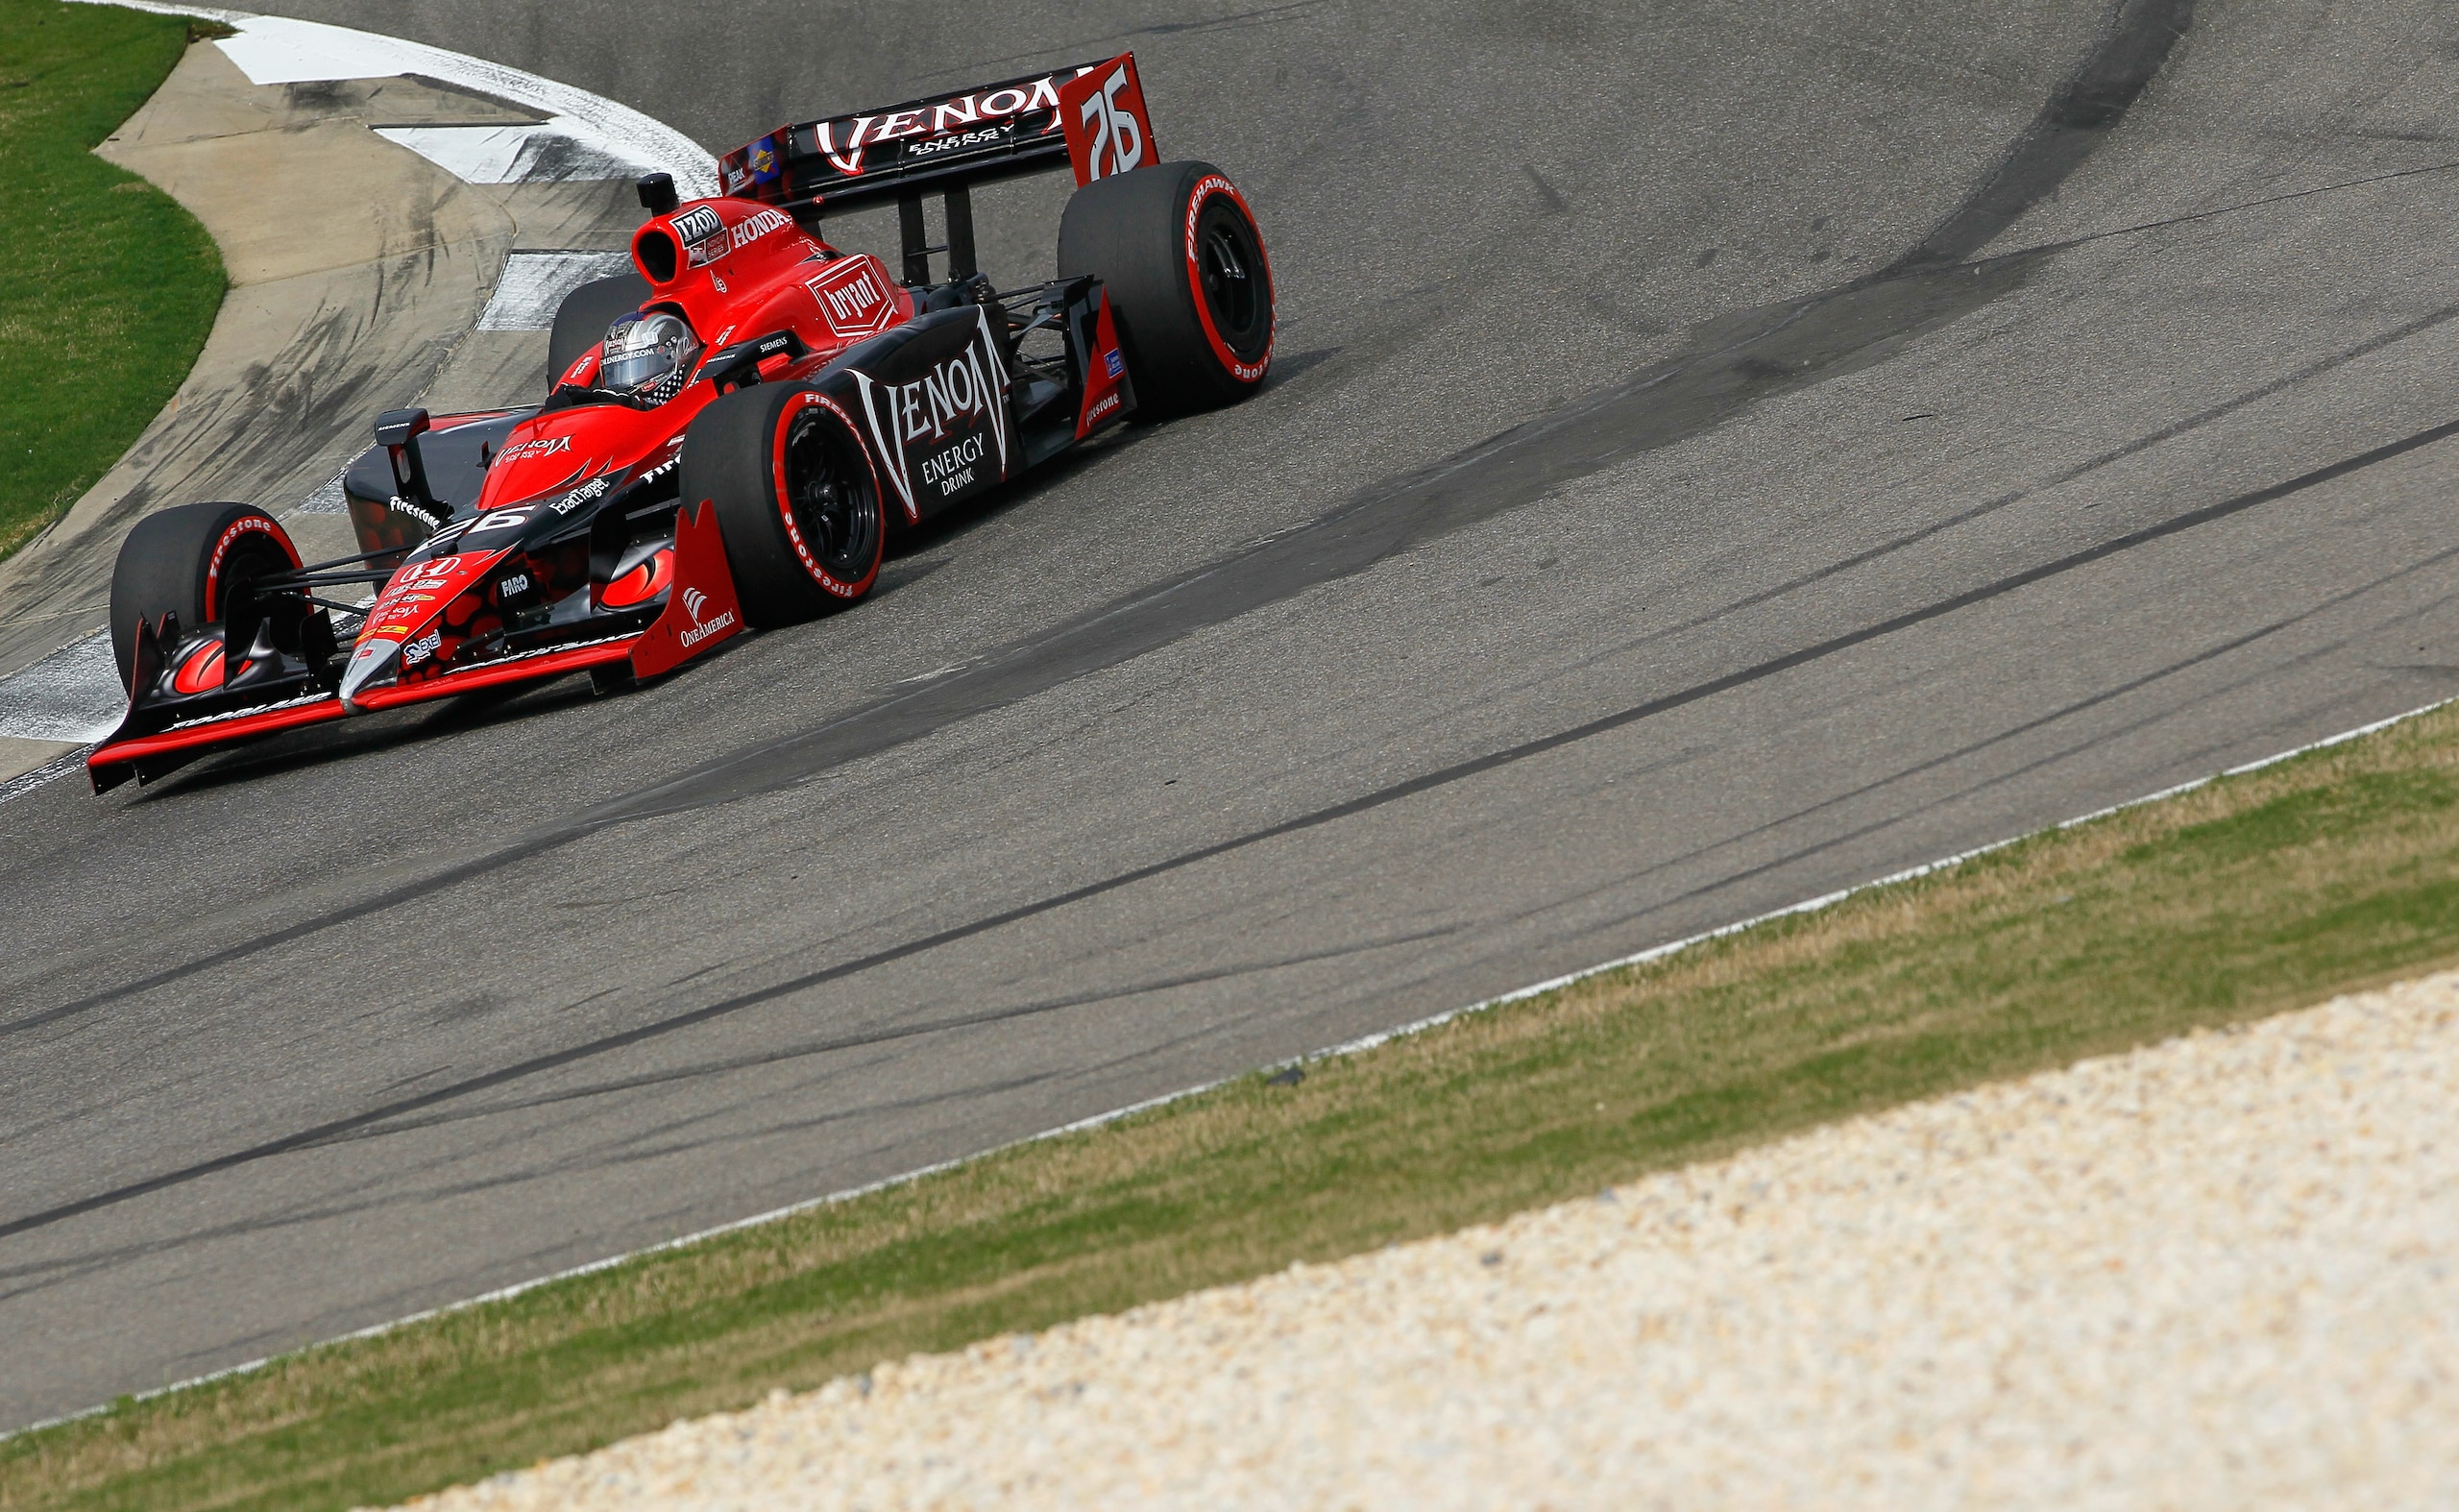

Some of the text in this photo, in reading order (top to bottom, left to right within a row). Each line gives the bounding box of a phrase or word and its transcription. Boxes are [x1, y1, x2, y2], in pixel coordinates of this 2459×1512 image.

[909, 124, 1014, 153] ENERGY
[1079, 62, 1142, 183] 26
[915, 133, 999, 156] DRINK
[675, 208, 718, 242] IZOD
[731, 208, 789, 249] HONDA
[1187, 178, 1234, 262] FIREHAWK
[823, 270, 881, 320] bryant
[760, 336, 789, 354] SIEMENS
[843, 304, 1011, 519] VENOM
[1085, 393, 1120, 427] Firestone
[921, 432, 986, 484] ENERGY
[548, 477, 610, 516] ExactTarget
[940, 467, 975, 496] DRINK
[389, 495, 441, 532] Firestone
[209, 519, 272, 578] Firestone
[784, 512, 854, 598] Firestone
[500, 573, 528, 597] FARO
[680, 610, 735, 648] ONEAMERICA
